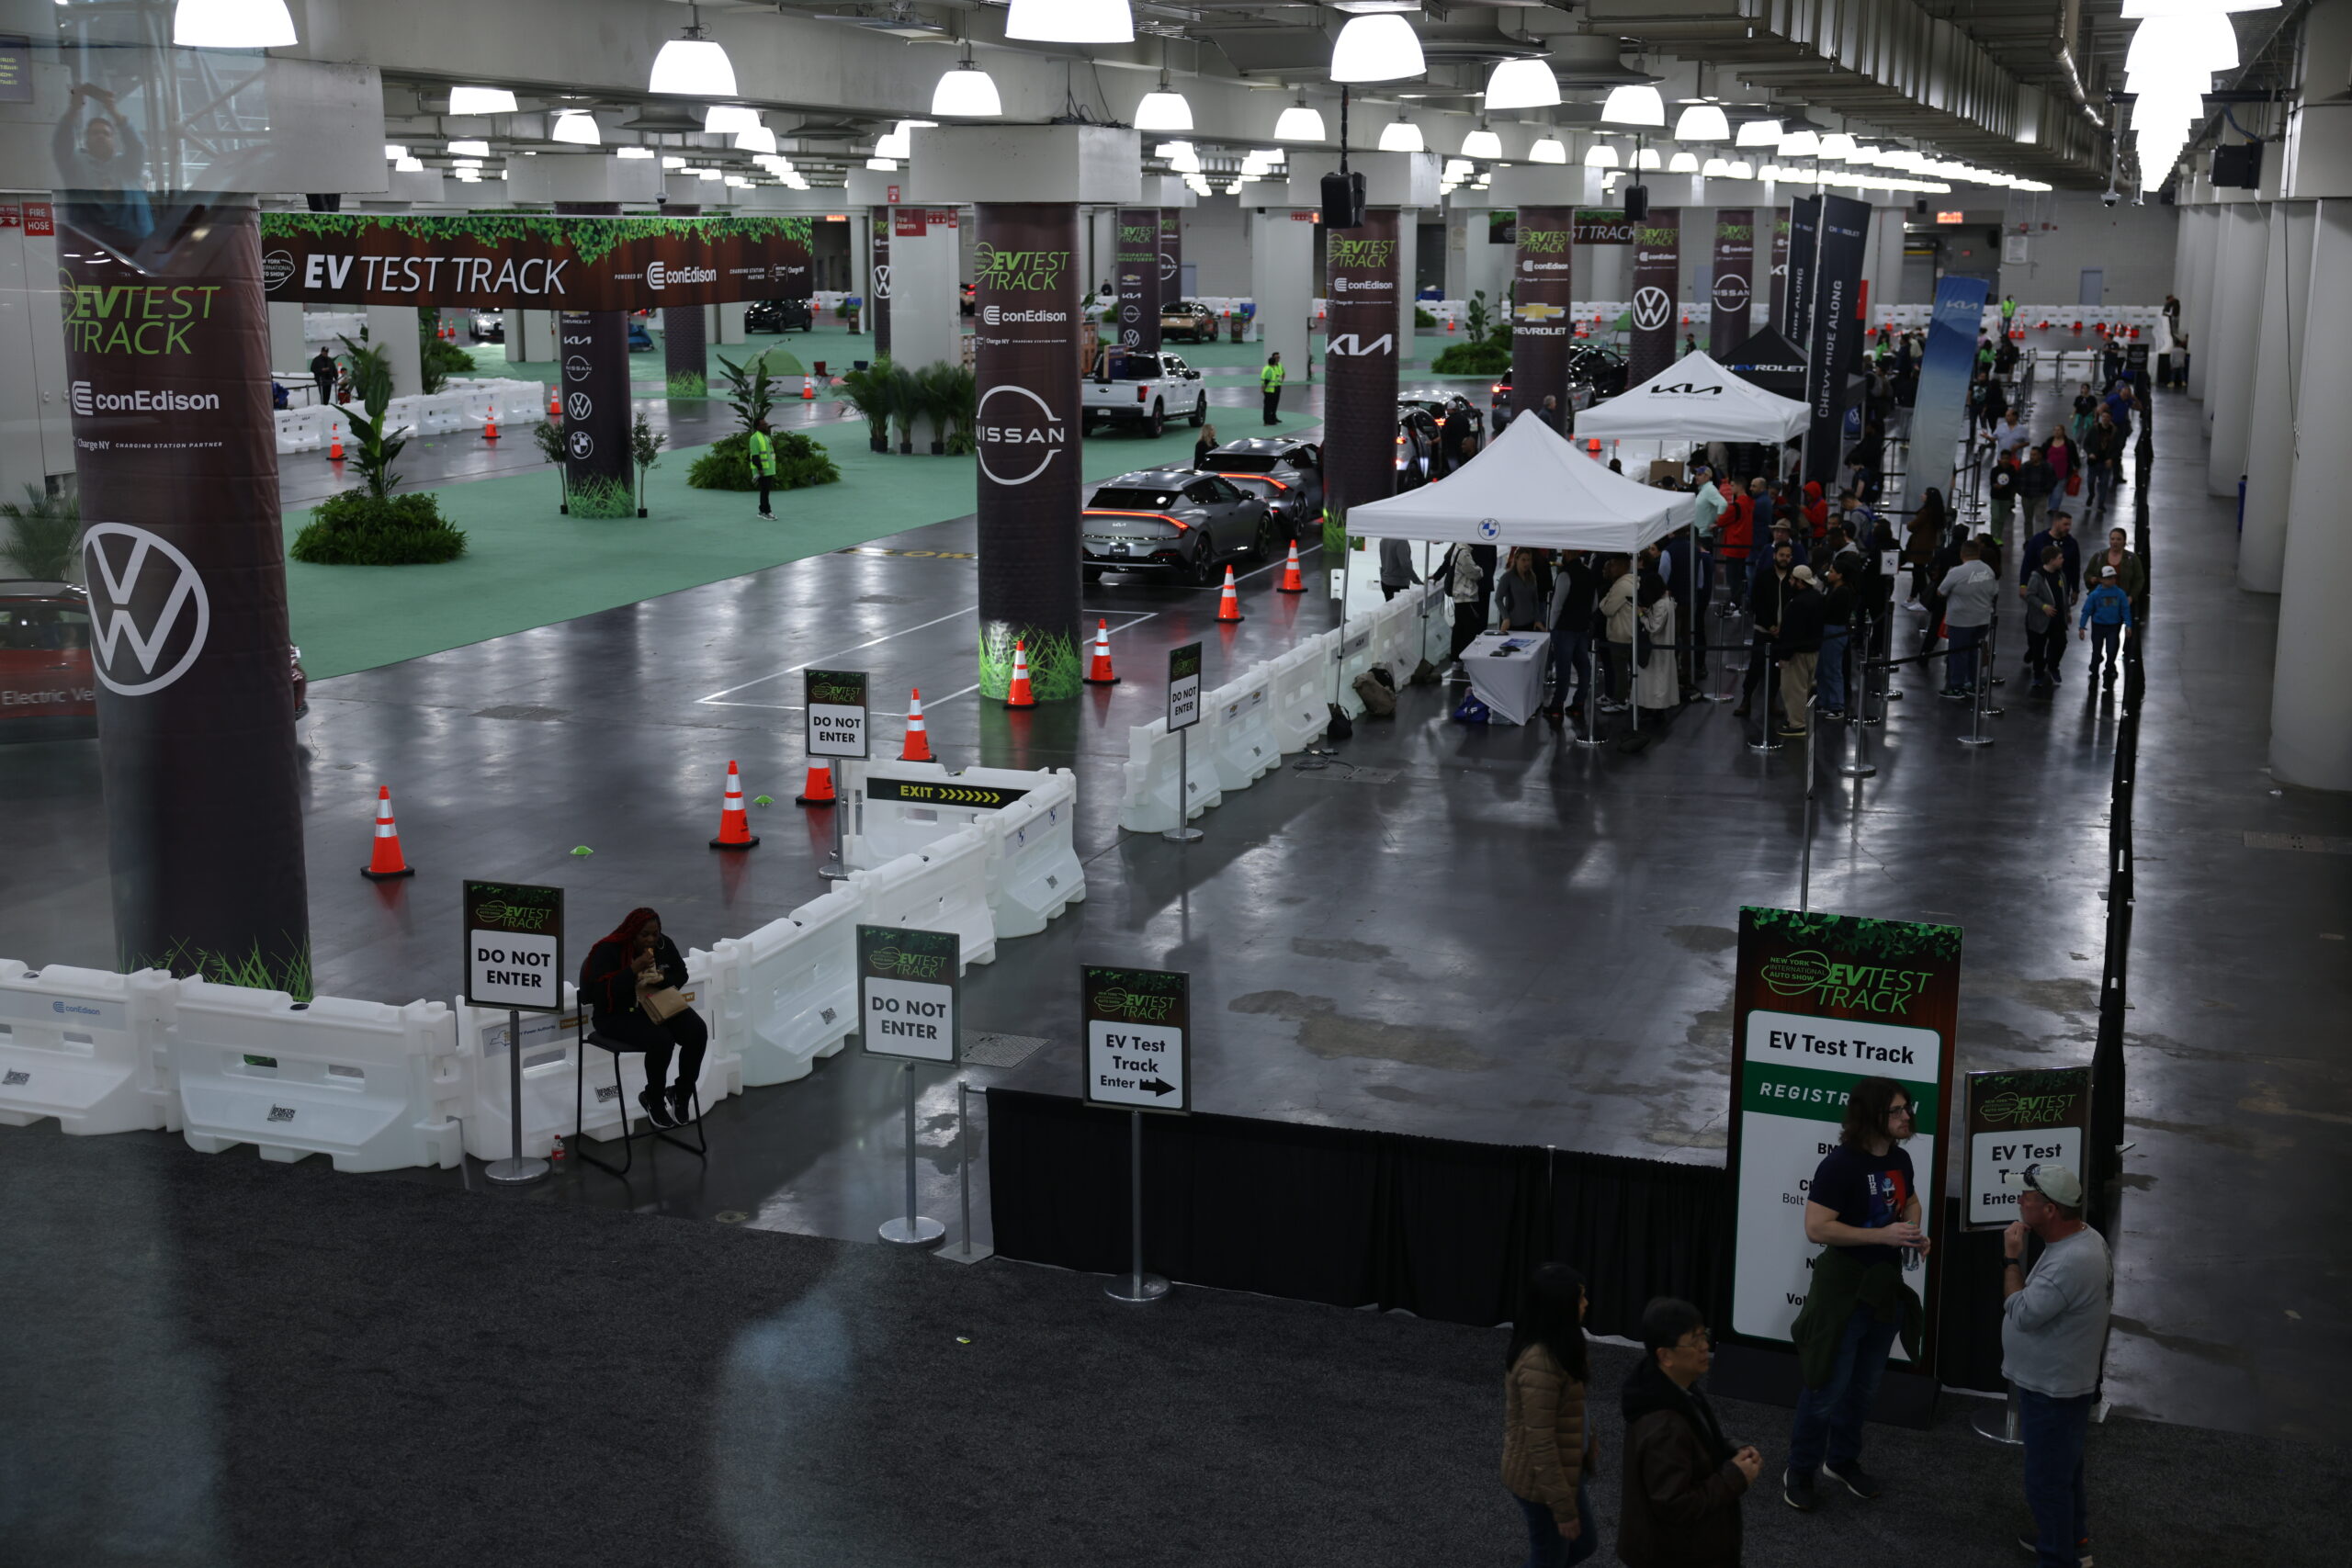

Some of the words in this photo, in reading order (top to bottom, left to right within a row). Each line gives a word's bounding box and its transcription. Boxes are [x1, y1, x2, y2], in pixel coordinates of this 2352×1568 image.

[29, 209, 45, 218] FIRE
[28, 220, 50, 231] HOSE
[1589, 225, 1635, 240] TRACK
[1122, 234, 1150, 243] TRACK
[1643, 238, 1674, 246] TRACK
[1527, 242, 1566, 254] TRACK
[1337, 254, 1388, 268] TRACK
[304, 254, 355, 289] EV
[360, 256, 446, 293] TEST
[451, 256, 570, 295] TRACK
[666, 266, 717, 284] conEdison
[989, 271, 1058, 291] TRACK
[1348, 280, 1393, 289] conEdison
[1795, 267, 1804, 310] ALONG
[1829, 279, 1842, 330] ALONG
[1001, 310, 1067, 322] conEdison
[1792, 312, 1801, 339] RIDE
[71, 321, 197, 355] TRACK
[563, 335, 592, 344] KIA
[1326, 333, 1392, 356] KIA
[1826, 332, 1837, 366] RIDE
[1651, 383, 1723, 395] KIA
[1818, 369, 1831, 418] CHEVY
[96, 389, 220, 411] conEdison
[975, 424, 1065, 444] NISSAN
[78, 438, 97, 451] Charge
[98, 440, 110, 450] NY
[2, 689, 67, 705] Electric
[829, 694, 855, 702] TRACK
[1172, 692, 1182, 703] DO
[1183, 686, 1196, 698] NOT
[1175, 701, 1193, 716] ENTER
[814, 716, 831, 727] DO
[836, 717, 861, 728] NOT
[820, 731, 855, 743] ENTER
[899, 785, 933, 798] EXIT
[502, 916, 544, 930] TRACK
[478, 948, 505, 964] DO
[512, 951, 550, 967] NOT
[1770, 956, 1788, 964] NEW
[1790, 958, 1809, 966] YORK
[896, 964, 938, 978] TRACK
[1770, 964, 1825, 976] INTERNATIONAL
[1770, 971, 1791, 979] AUTO
[1792, 973, 1815, 982] SHOW
[487, 970, 542, 987] ENTER
[1816, 984, 1912, 1015] TRACK
[872, 997, 899, 1013] DO
[906, 1000, 946, 1018] NOT
[1121, 1005, 1168, 1021] TRACK
[881, 1020, 937, 1040] ENTER
[1106, 1033, 1126, 1048] EV
[1132, 1036, 1165, 1053] Test
[1770, 1031, 1797, 1050] EV
[1802, 1034, 1848, 1057] Test
[1852, 1040, 1914, 1065] Track
[1113, 1055, 1159, 1073] Track
[1100, 1075, 1136, 1089] Enter
[2013, 1108, 2065, 1124] TRACK
[1817, 1143, 1838, 1155] BM
[1992, 1145, 2017, 1161] EV
[2022, 1143, 2062, 1159] Test
[1782, 1192, 1804, 1206] Bolt
